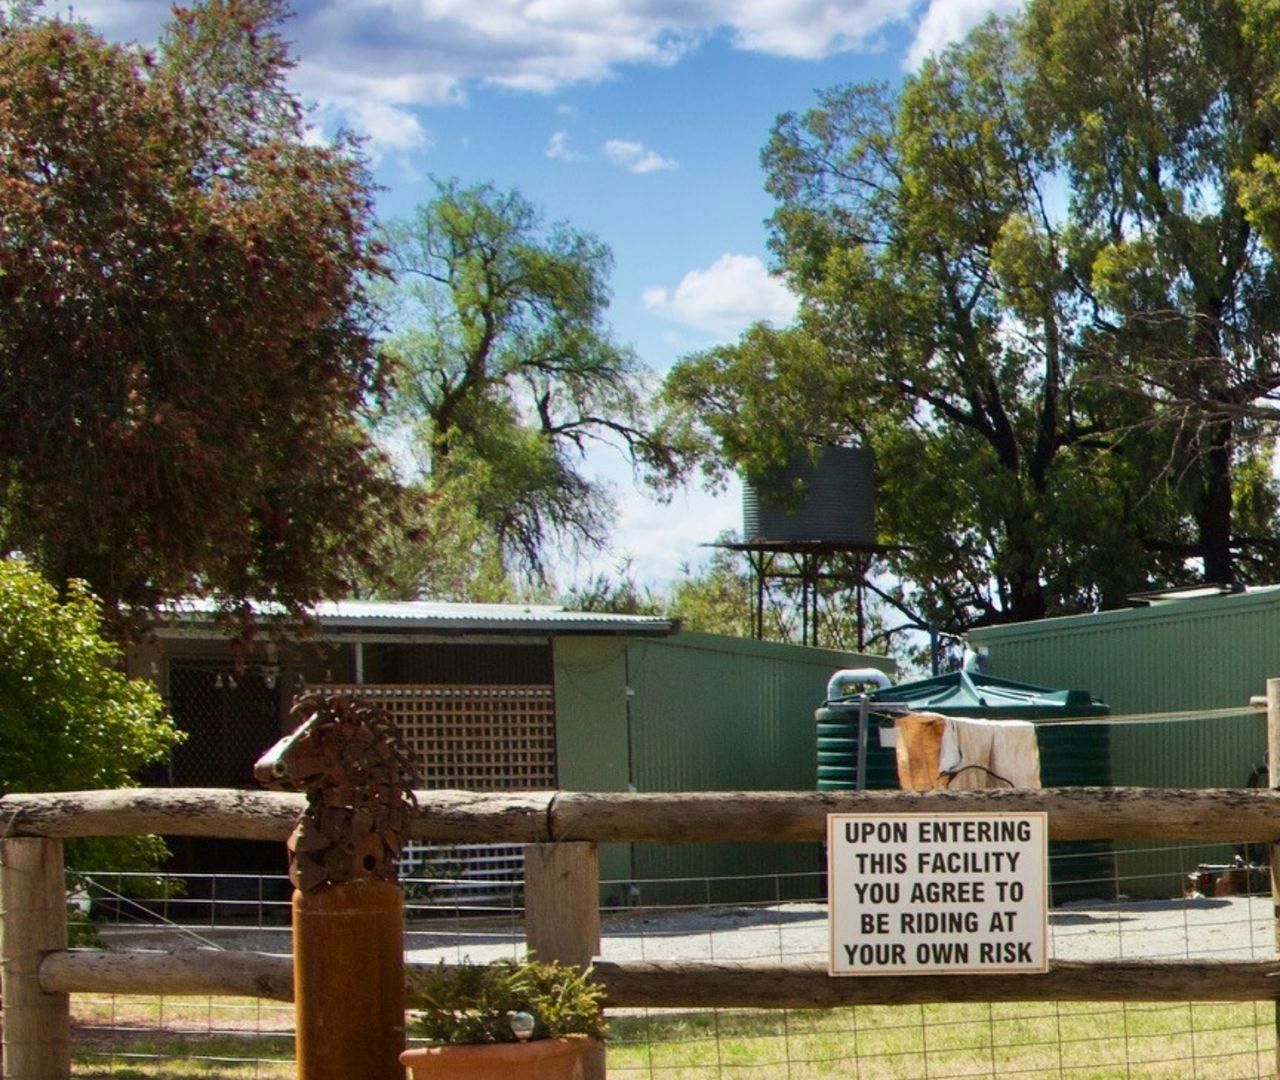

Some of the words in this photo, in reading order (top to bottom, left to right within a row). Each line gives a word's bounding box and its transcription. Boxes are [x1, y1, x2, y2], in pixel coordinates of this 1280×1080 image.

[846, 822, 907, 843] UPON
[919, 821, 1030, 842] ENTERING
[856, 853, 906, 874] THIS
[918, 852, 1019, 873] FACILITY
[855, 883, 899, 904] YOU
[911, 882, 984, 903] AGREE
[996, 882, 1023, 902] TO
[861, 914, 889, 934] BE
[901, 912, 978, 933] RIDING
[990, 912, 1017, 932] AT
[844, 944, 906, 965] YOUR
[917, 943, 968, 964] OWN
[980, 942, 1032, 963] RISK
